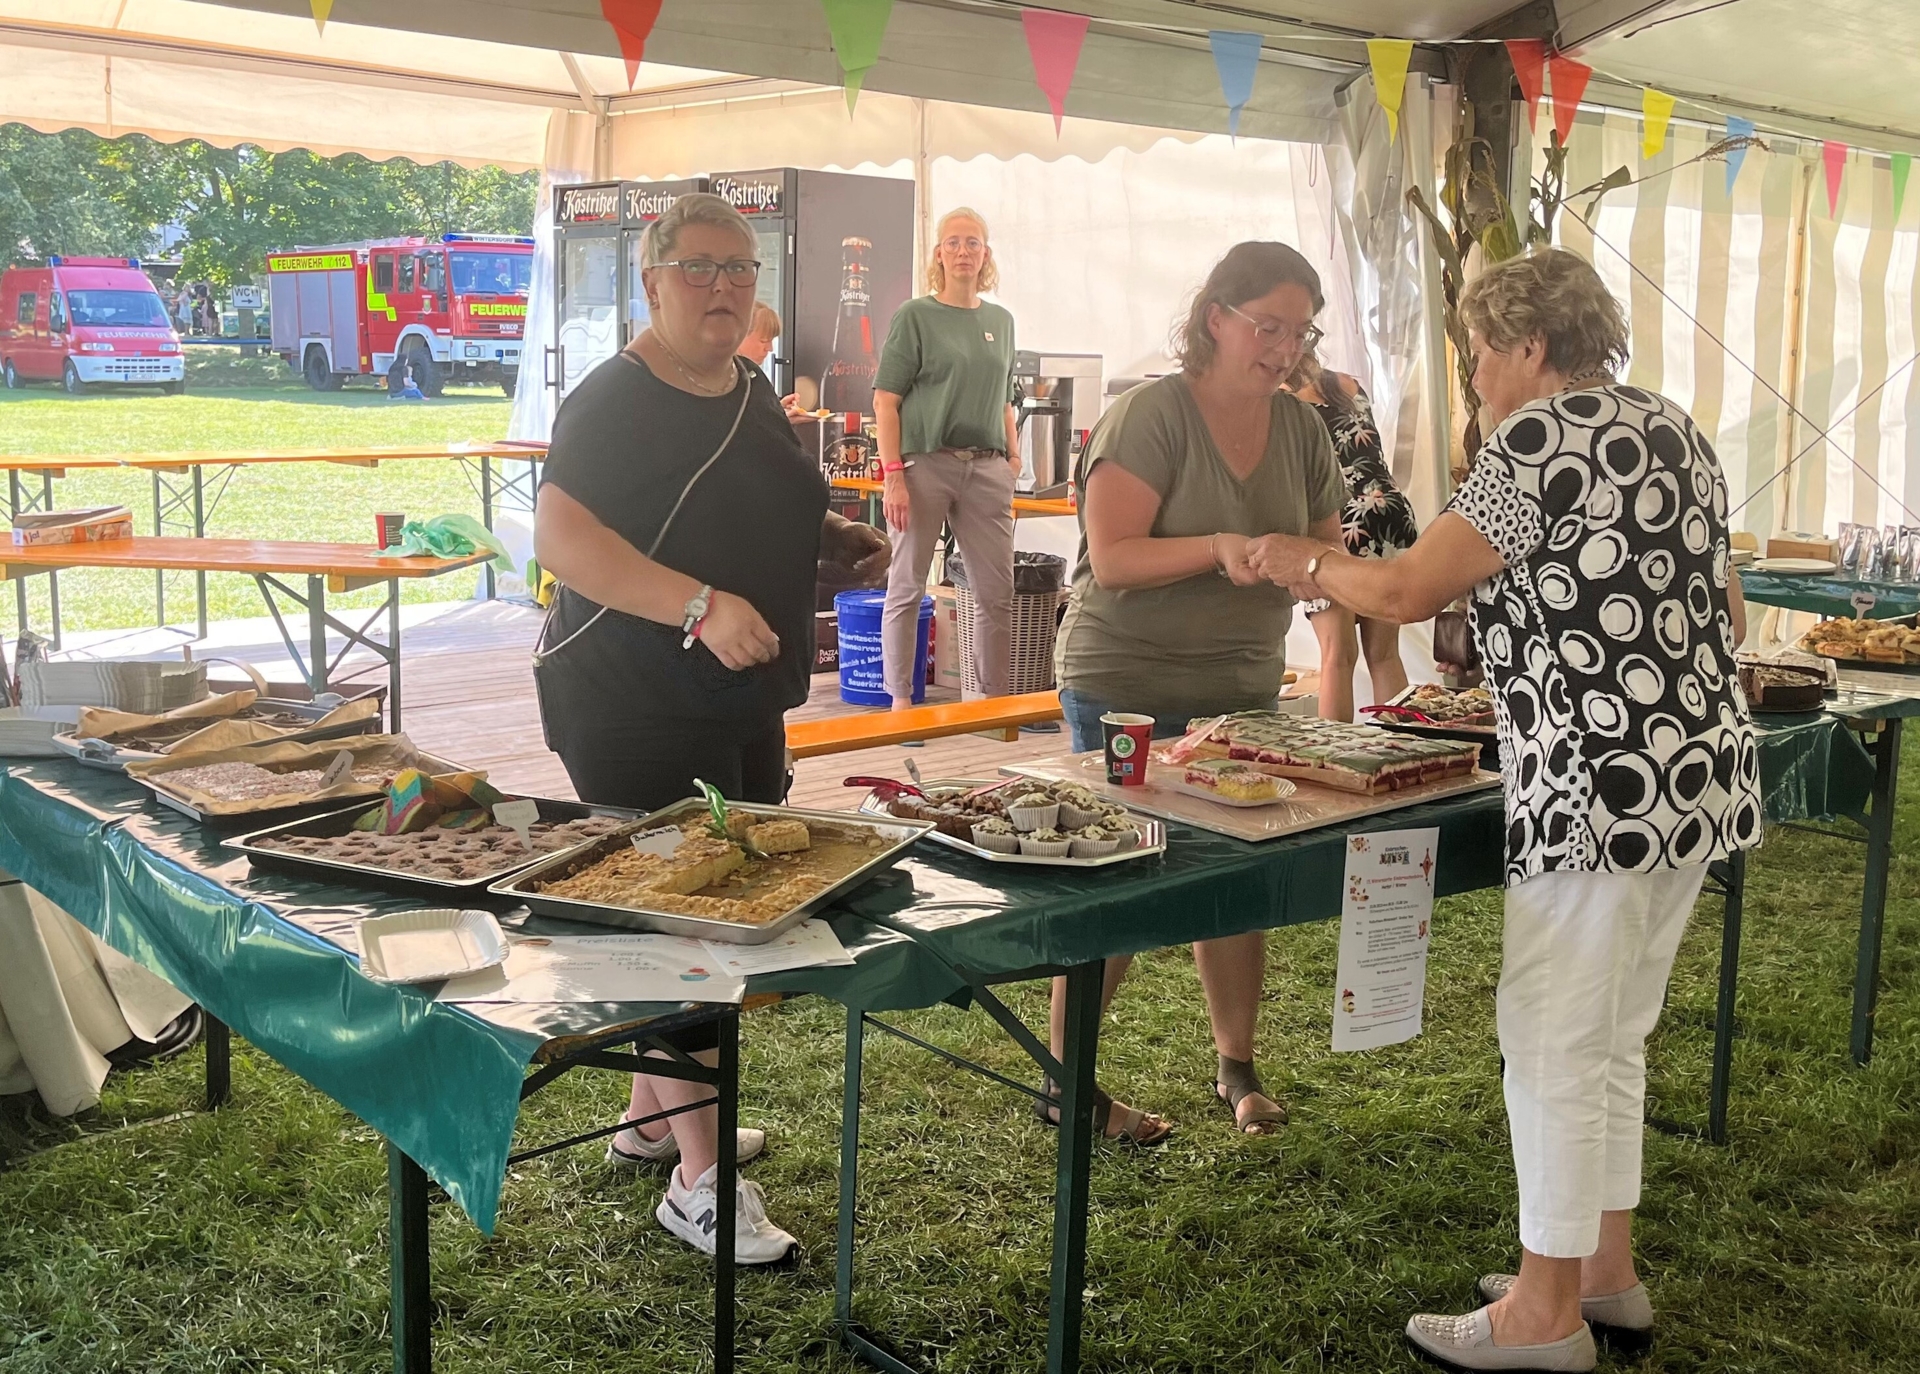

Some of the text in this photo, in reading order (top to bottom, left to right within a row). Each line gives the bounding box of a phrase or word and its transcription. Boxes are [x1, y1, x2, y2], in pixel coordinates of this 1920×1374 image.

[715, 177, 779, 211] Köstritzer
[561, 189, 619, 222] Köstritzer
[625, 188, 677, 220] Köstritz
[277, 256, 347, 270] FEUERWEHR 112
[234, 287, 250, 297] WC
[840, 288, 871, 302] Köstritzer
[470, 304, 527, 316] FEUERWE
[499, 323, 519, 331] IVECO
[96, 331, 168, 339] FEUERWEHR
[853, 669, 882, 679] Gurken
[848, 678, 884, 688] Sauerkra
[577, 937, 654, 945] Preisliste
